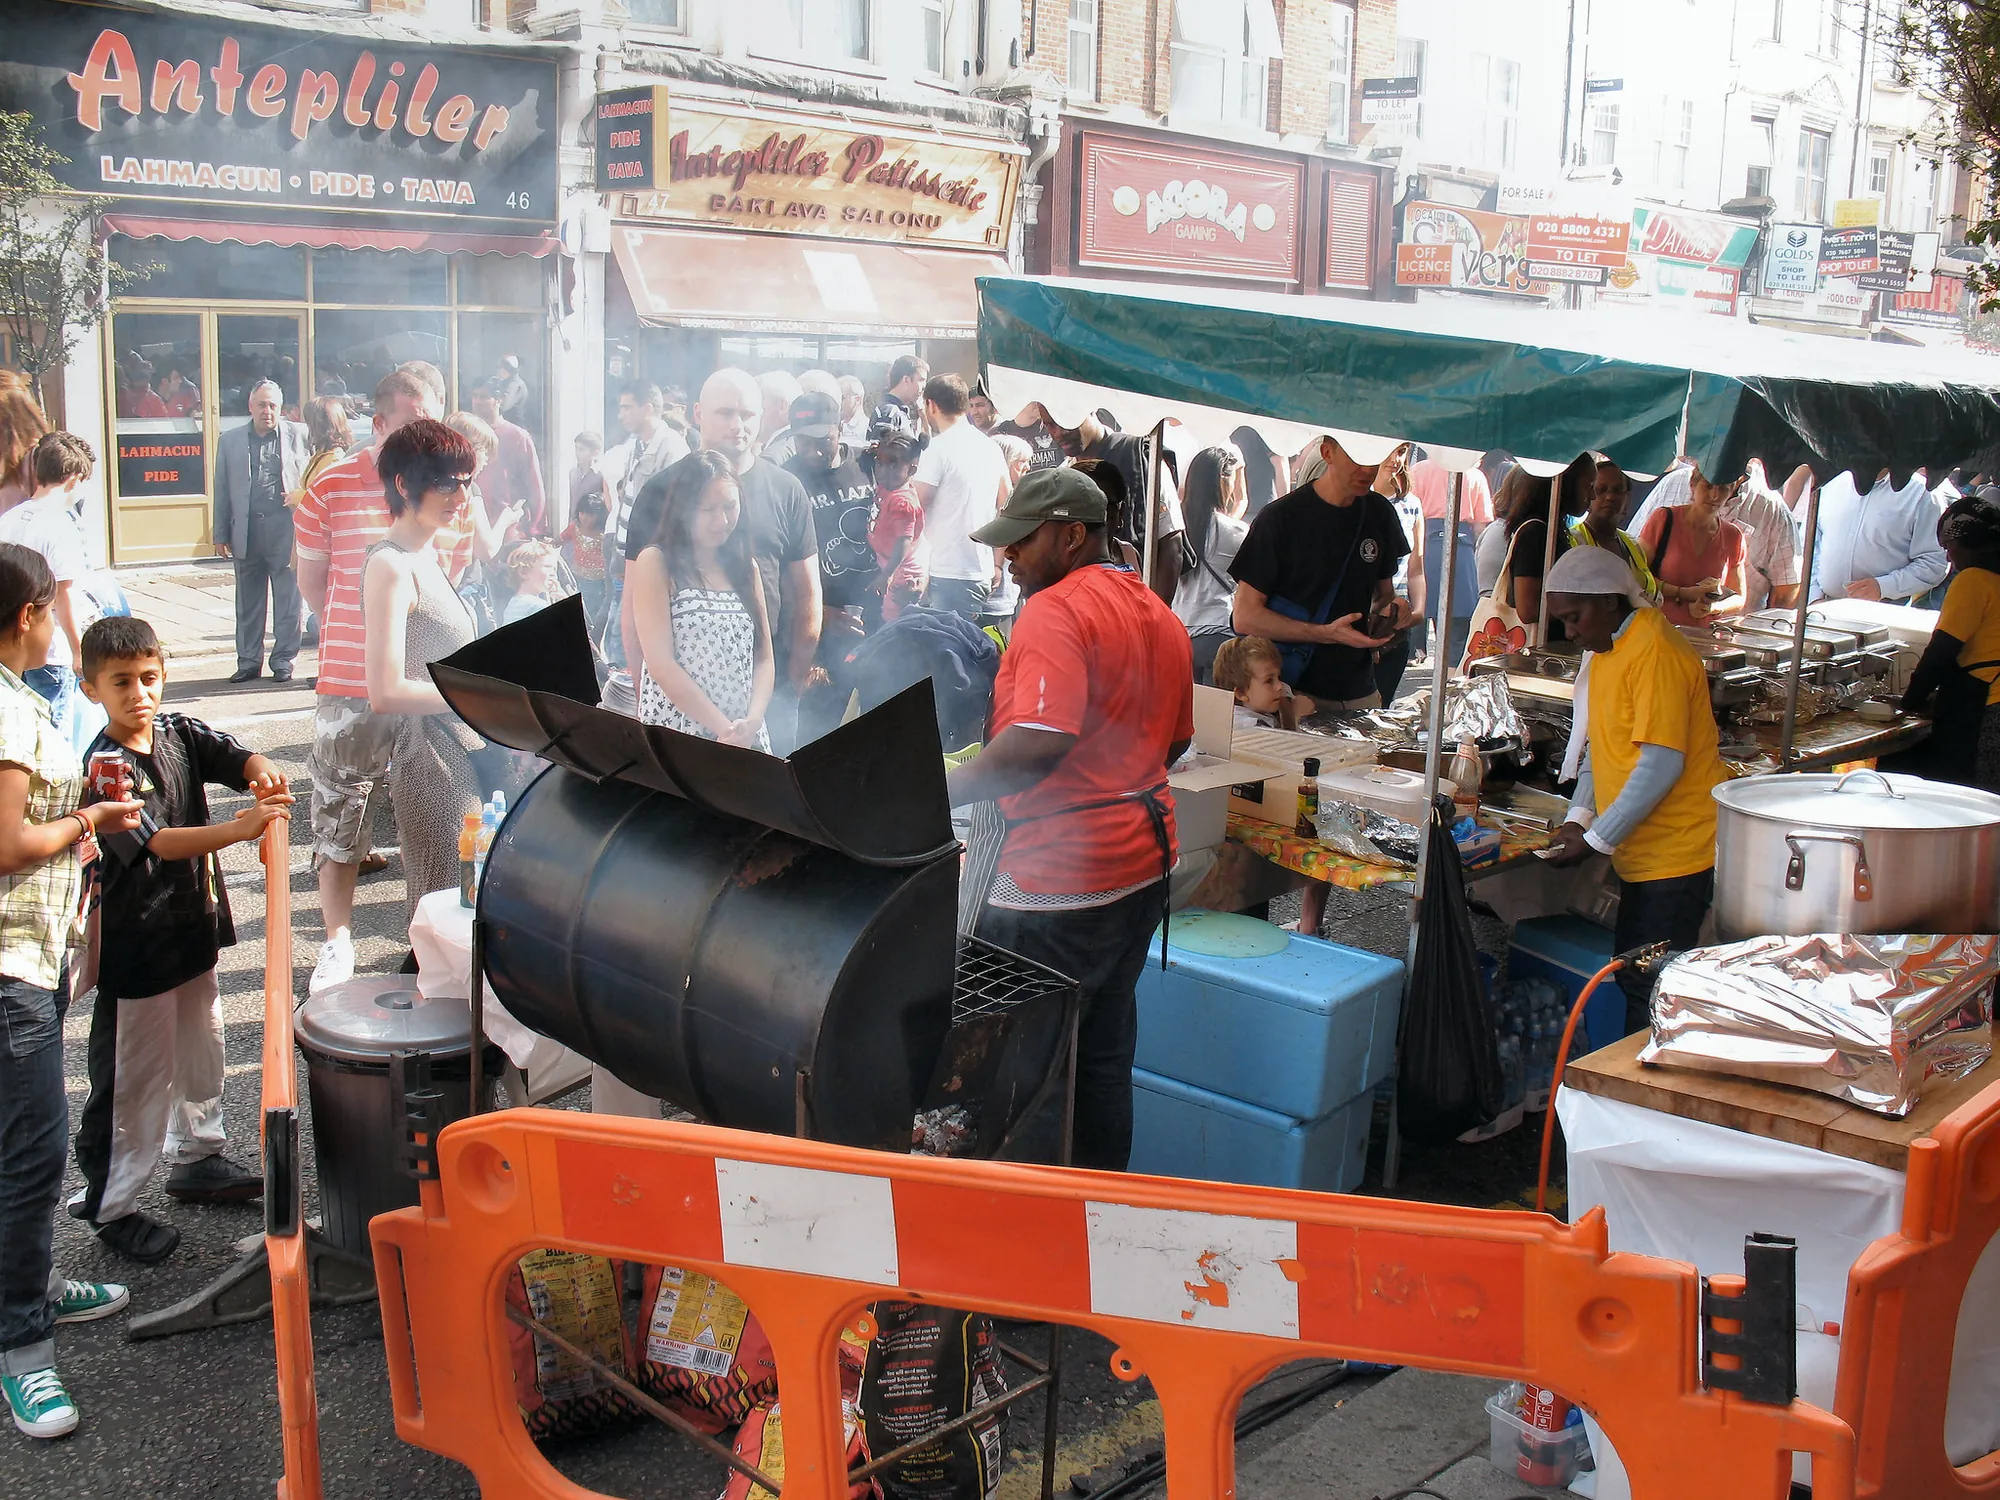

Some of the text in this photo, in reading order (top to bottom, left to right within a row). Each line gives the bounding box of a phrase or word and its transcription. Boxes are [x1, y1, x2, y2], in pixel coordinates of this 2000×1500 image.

[66, 28, 509, 151] Antepliler
[599, 99, 653, 119] LAHMACUN
[1377, 98, 1407, 109] TO LET
[610, 129, 641, 149] PIDE
[607, 160, 644, 180] TAVA
[670, 129, 989, 213] Antepliler Patisserie
[101, 155, 476, 205] LAHMACUN PIDE TAVA
[1502, 187, 1544, 200] FOR SALE
[506, 190, 531, 211] 46
[1175, 222, 1217, 242] GAMING
[1536, 222, 1621, 238] 020 8800 4321
[1850, 232, 1877, 242] norris
[1891, 241, 1913, 250] Homes
[1415, 247, 1437, 259] OFF
[1555, 250, 1599, 263] TO LET
[1774, 247, 1814, 261] GOLDS
[1880, 249, 1911, 258] MERCIAL
[1400, 260, 1450, 273] LICENCE
[1530, 266, 1549, 275] 020
[1575, 269, 1600, 279] 8787
[1820, 260, 1872, 272] SHOP TO LET
[1406, 273, 1442, 283] OPEN
[1776, 273, 1806, 282] TO LET
[120, 445, 201, 458] LAHMACUN
[144, 470, 179, 482] PIDE
[655, 1338, 689, 1351] WARNING!
